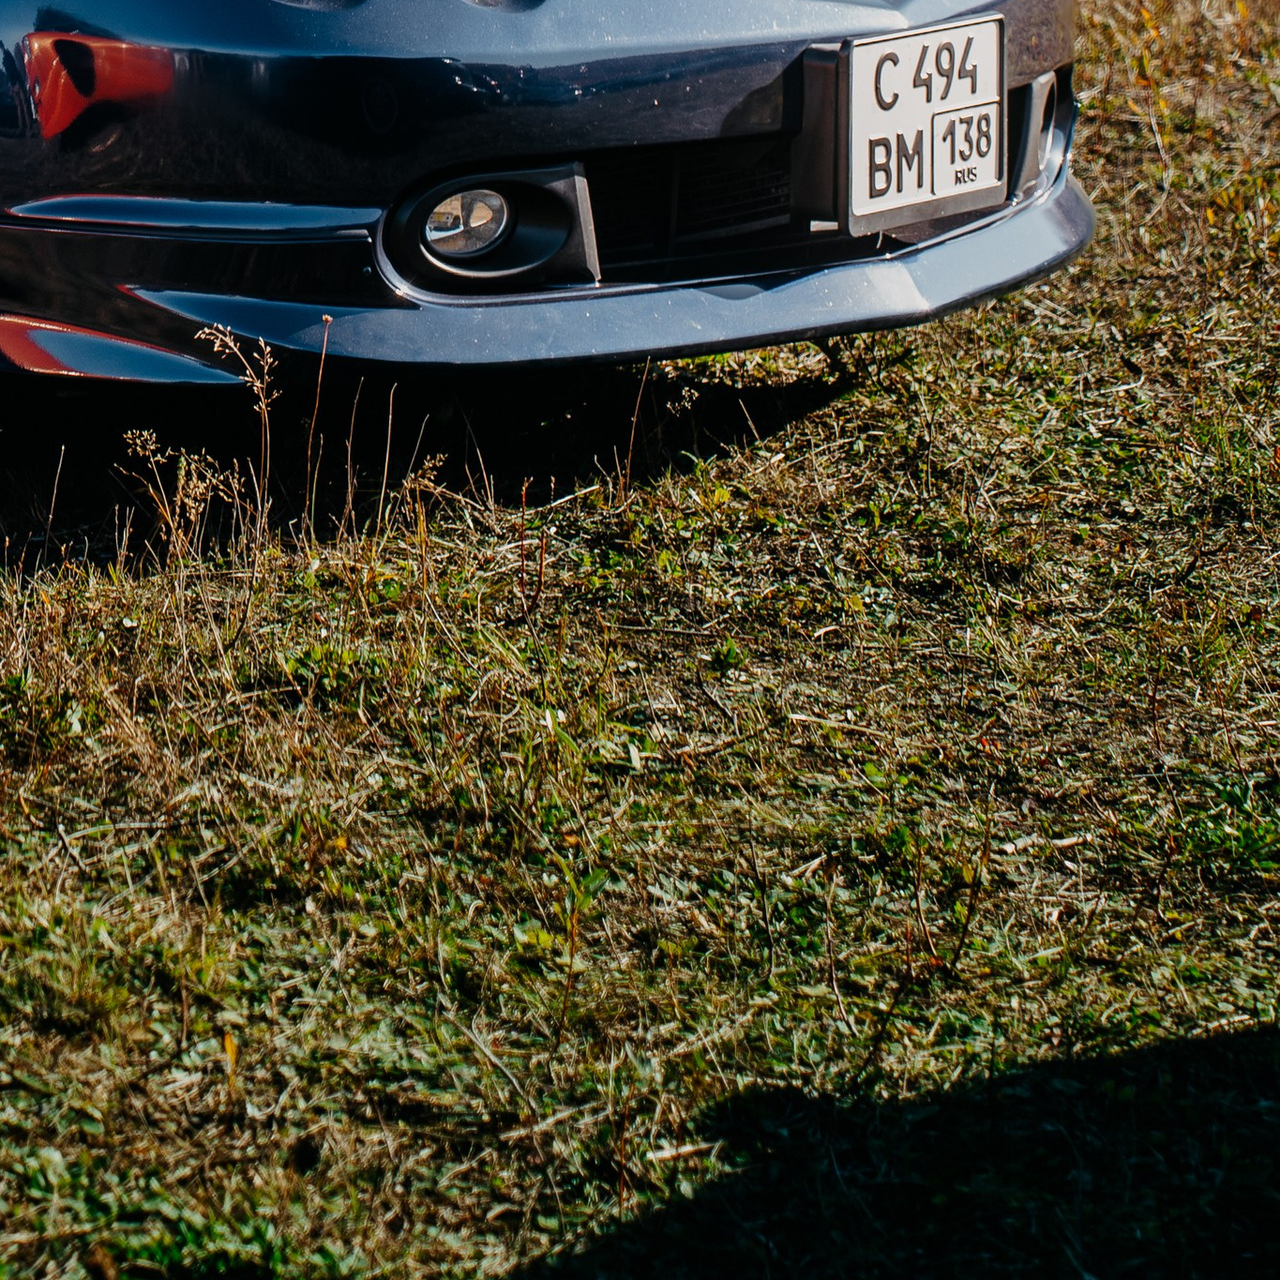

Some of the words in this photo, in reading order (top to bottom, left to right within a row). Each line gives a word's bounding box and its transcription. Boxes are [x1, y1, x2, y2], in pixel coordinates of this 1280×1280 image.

[912, 35, 978, 104] 494
[942, 112, 992, 165] 138
[954, 166, 978, 186] RUS
